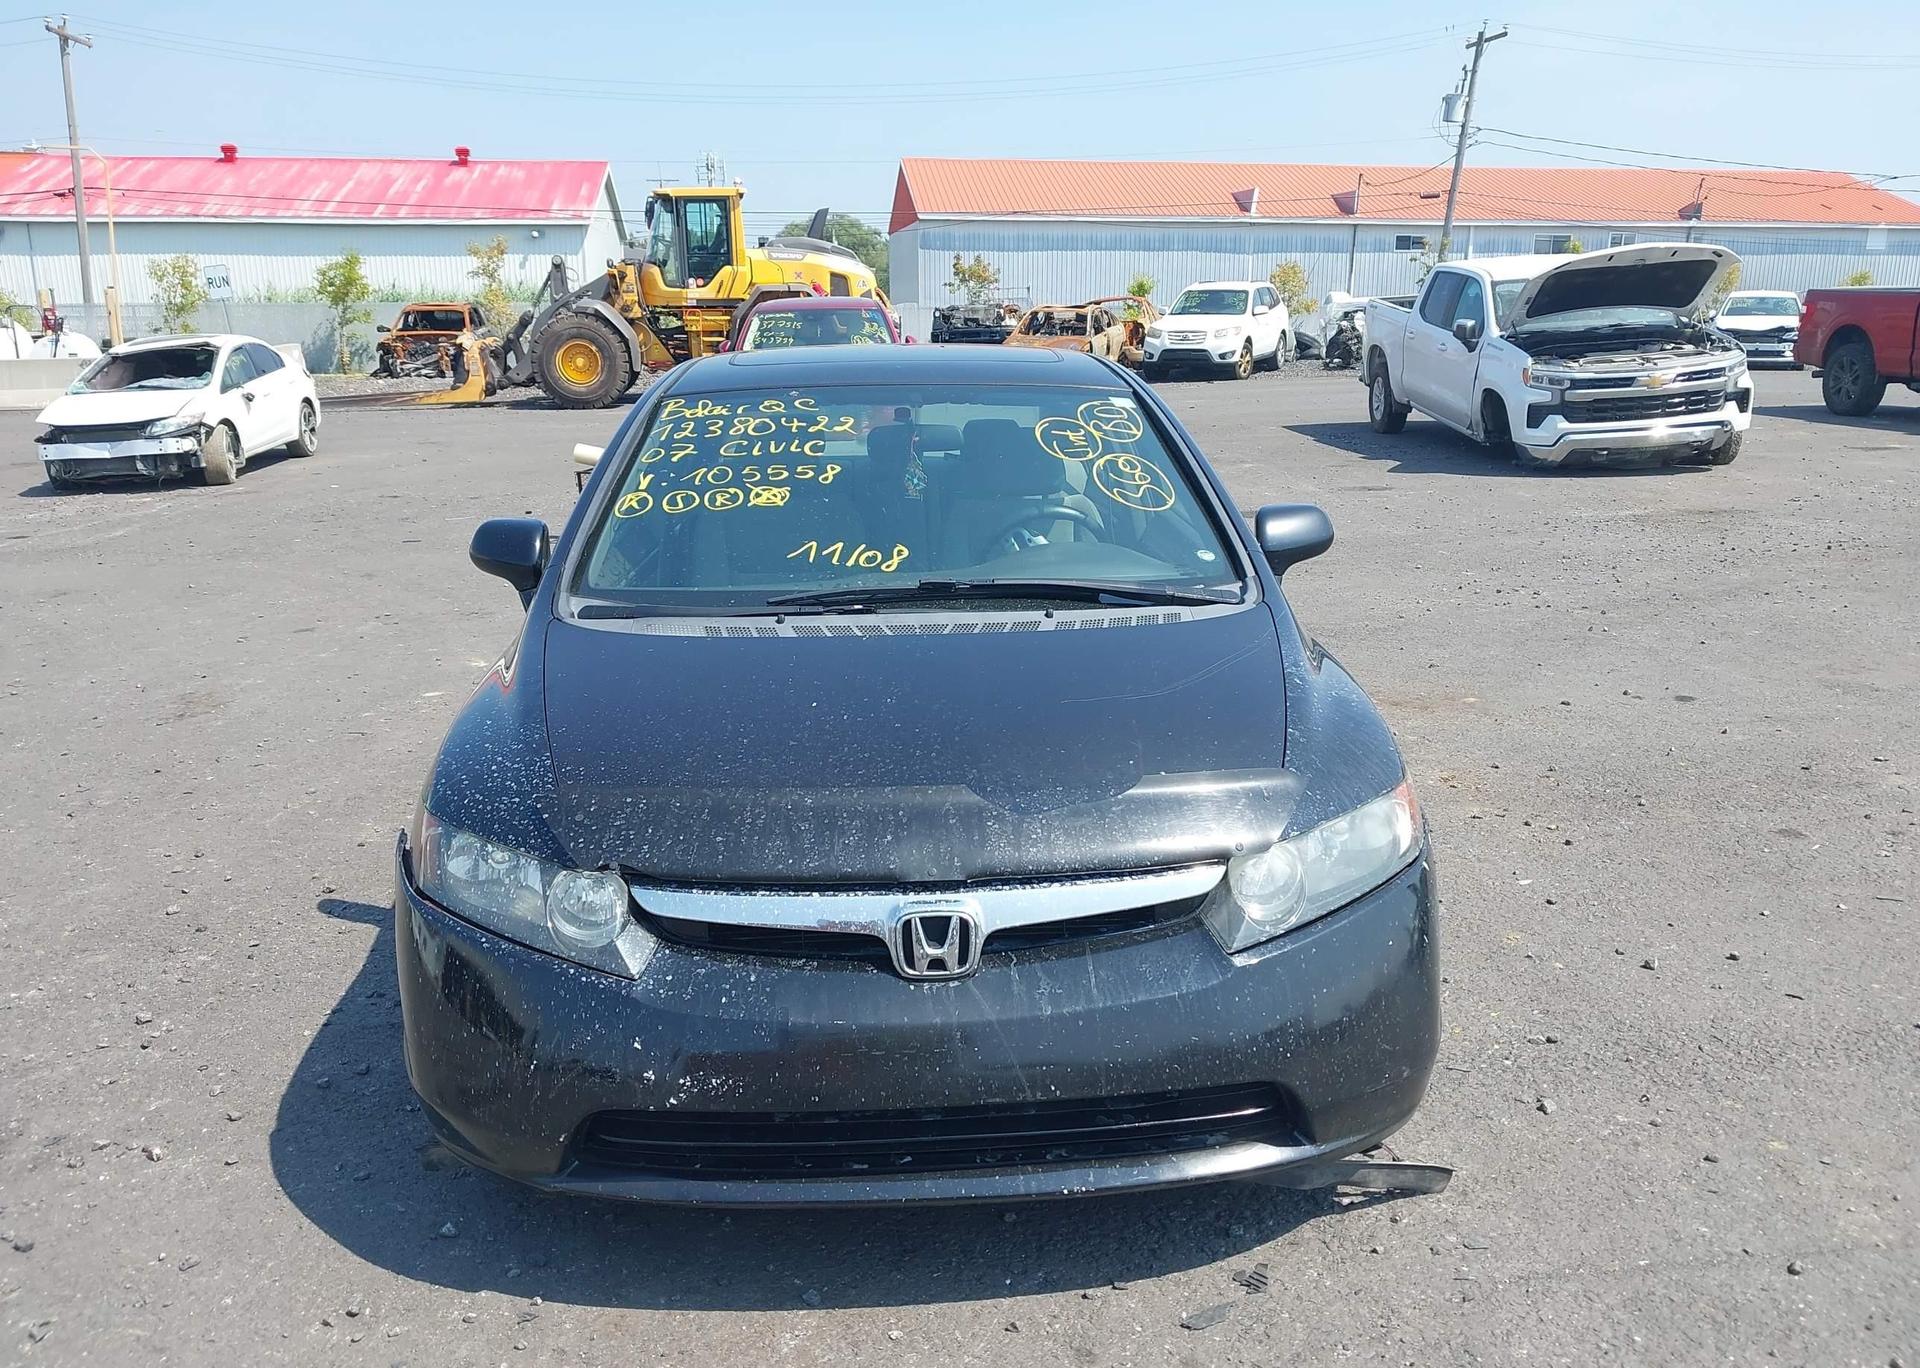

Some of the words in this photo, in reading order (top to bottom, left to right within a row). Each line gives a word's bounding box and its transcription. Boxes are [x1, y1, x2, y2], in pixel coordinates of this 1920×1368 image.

[207, 275, 230, 289] RUN
[651, 416, 858, 441] 12380422
[640, 443, 698, 462] 07
[680, 464, 842, 485] 105558
[786, 540, 909, 572] 11/08
